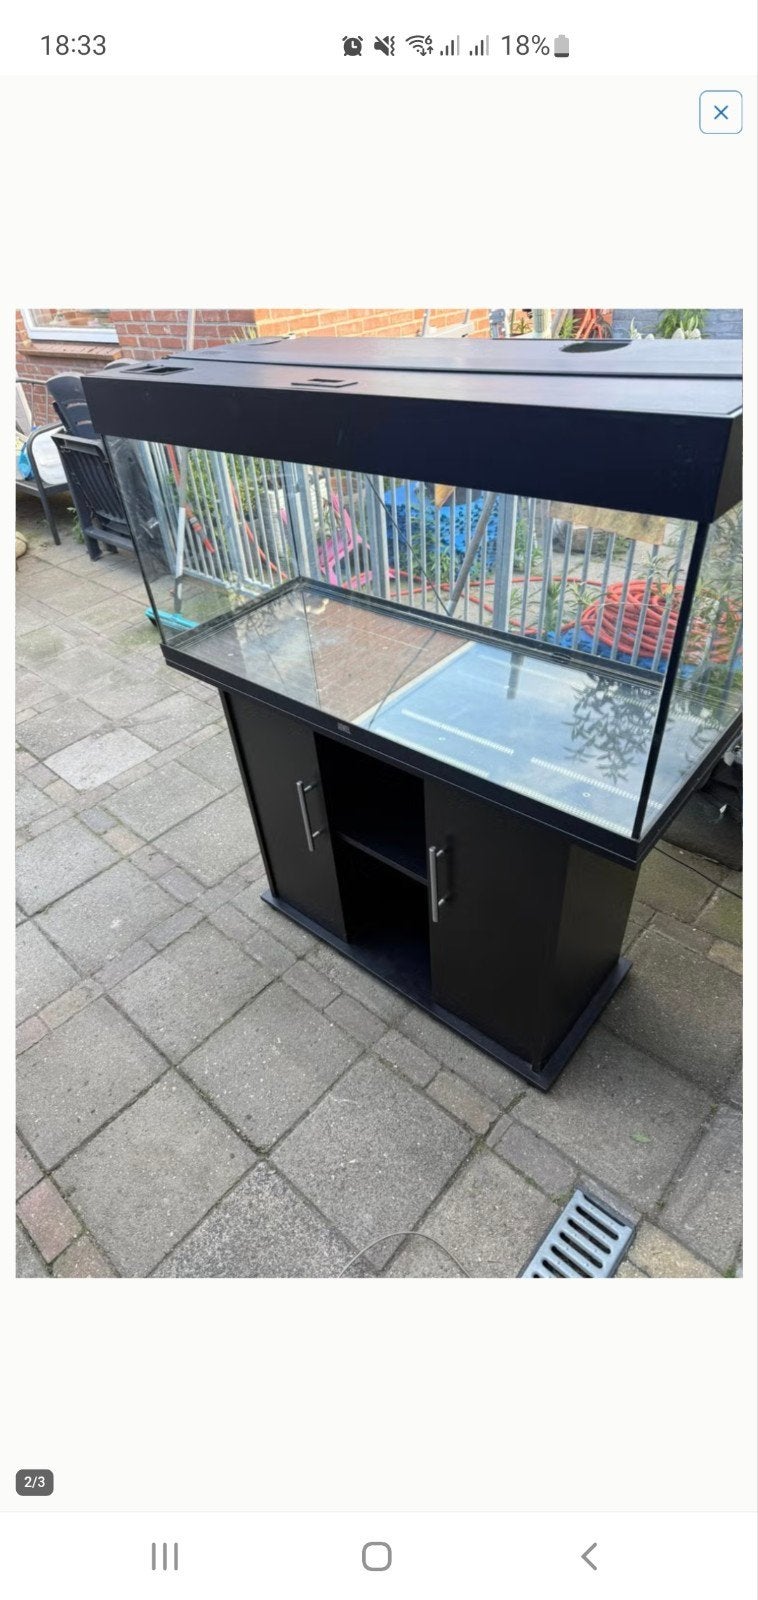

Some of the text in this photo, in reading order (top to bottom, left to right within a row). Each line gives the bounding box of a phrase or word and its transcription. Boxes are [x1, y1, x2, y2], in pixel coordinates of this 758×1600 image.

[41, 34, 106, 56] 18:33
[501, 34, 550, 56] 18%
[24, 1475, 46, 1489] 2/3
